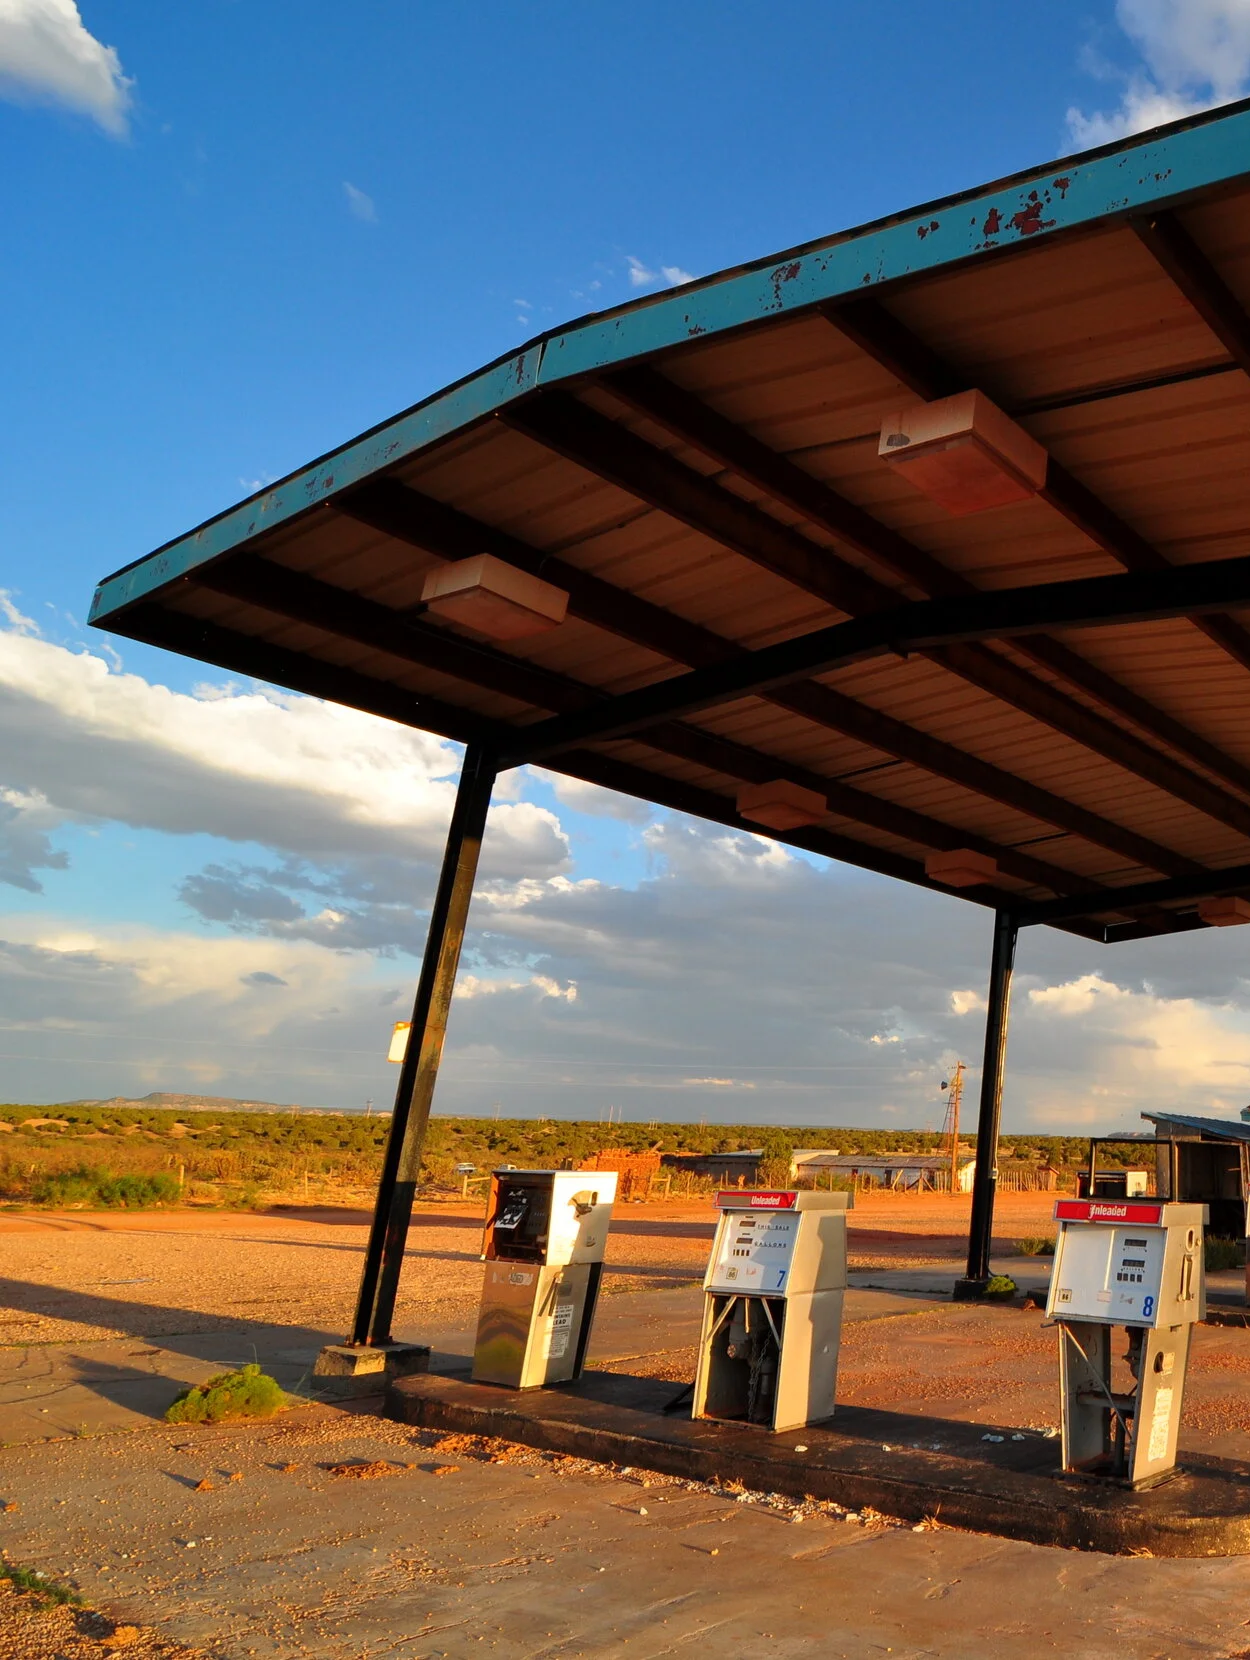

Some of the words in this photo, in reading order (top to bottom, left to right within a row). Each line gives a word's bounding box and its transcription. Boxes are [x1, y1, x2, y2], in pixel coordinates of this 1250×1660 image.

[751, 1195, 781, 1205] Unleaded
[776, 1270, 787, 1288] 7
[1143, 1296, 1154, 1317] 8
